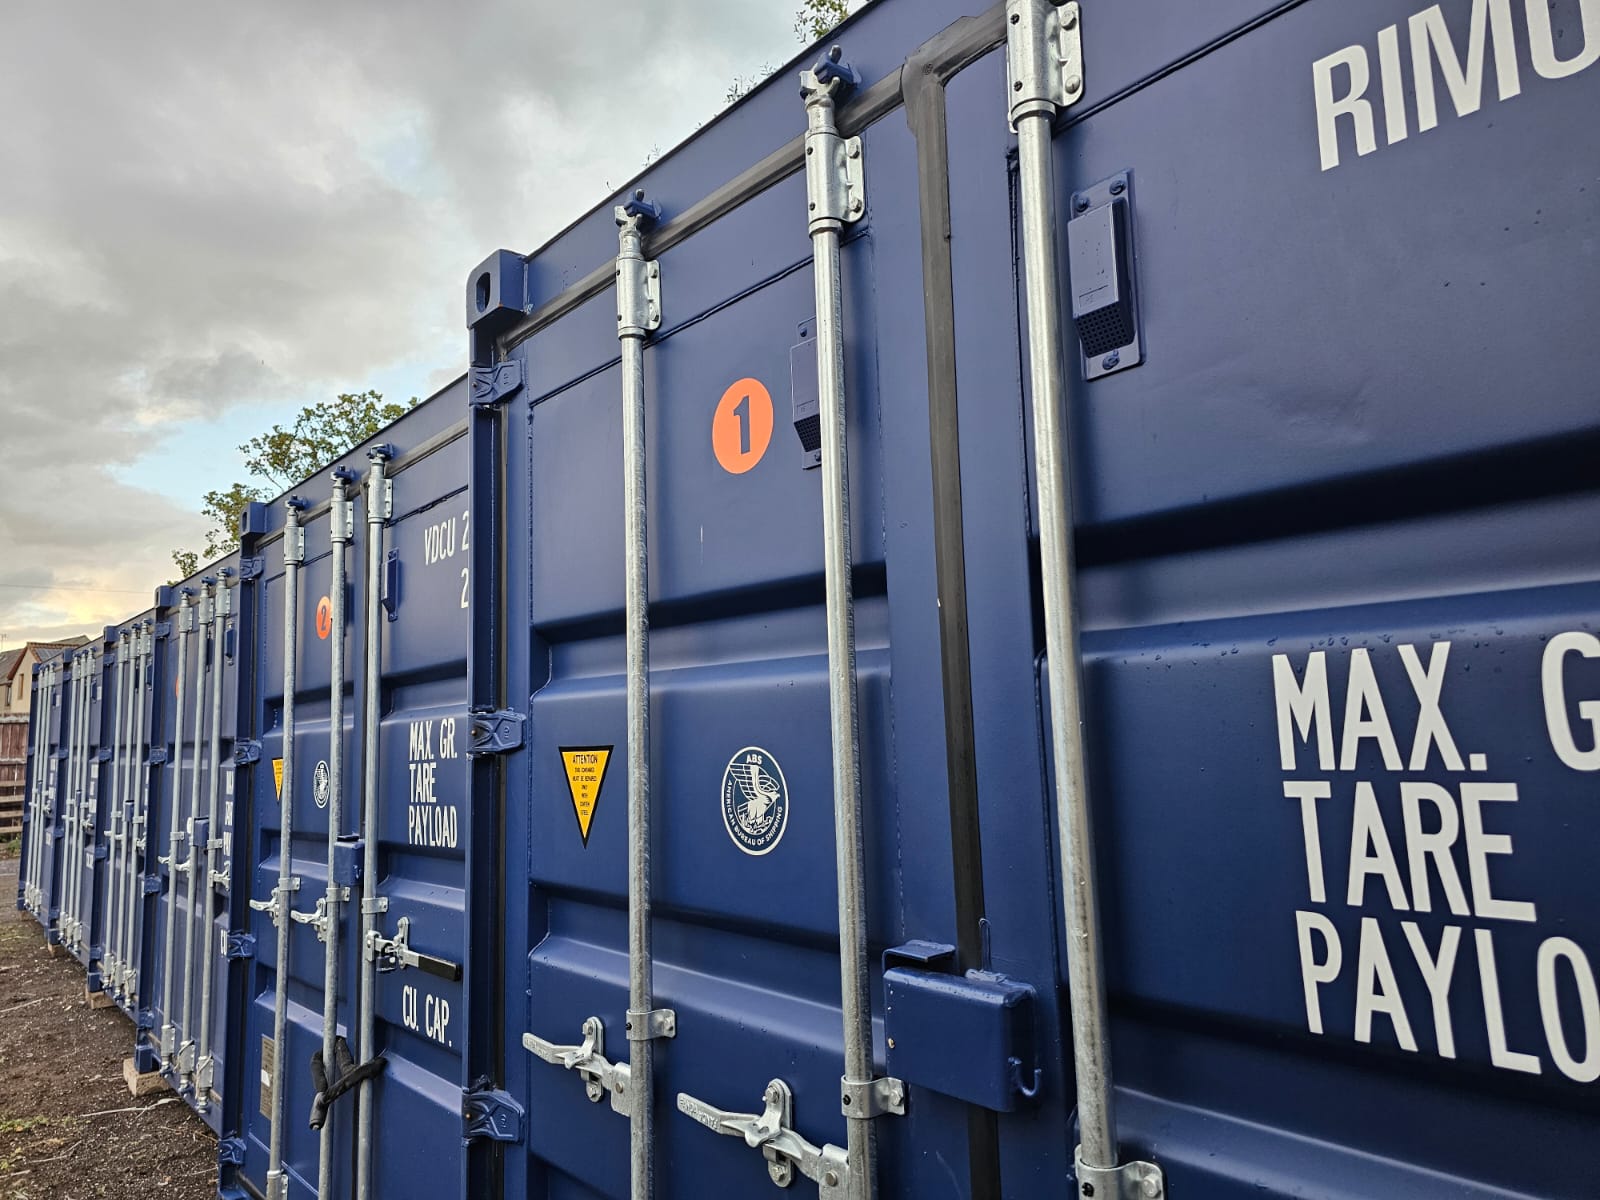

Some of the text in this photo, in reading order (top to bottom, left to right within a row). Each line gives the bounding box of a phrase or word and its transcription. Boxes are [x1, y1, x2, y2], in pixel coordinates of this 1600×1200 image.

[733, 395, 751, 455] 1
[425, 517, 456, 566] VDCU
[1272, 641, 1487, 771] MAX.
[409, 718, 458, 761] MAX. GR.
[573, 754, 598, 764] ATTENTION
[746, 754, 763, 765] ABS
[409, 762, 437, 803] TARE
[408, 805, 458, 848] PAYLOAD
[726, 779, 783, 847] AMERICAN BUREAU OF SHIPPING
[1283, 781, 1537, 922] TARE
[403, 985, 453, 1047] CU. CAP.
[1295, 910, 1600, 1083] PAYLO
